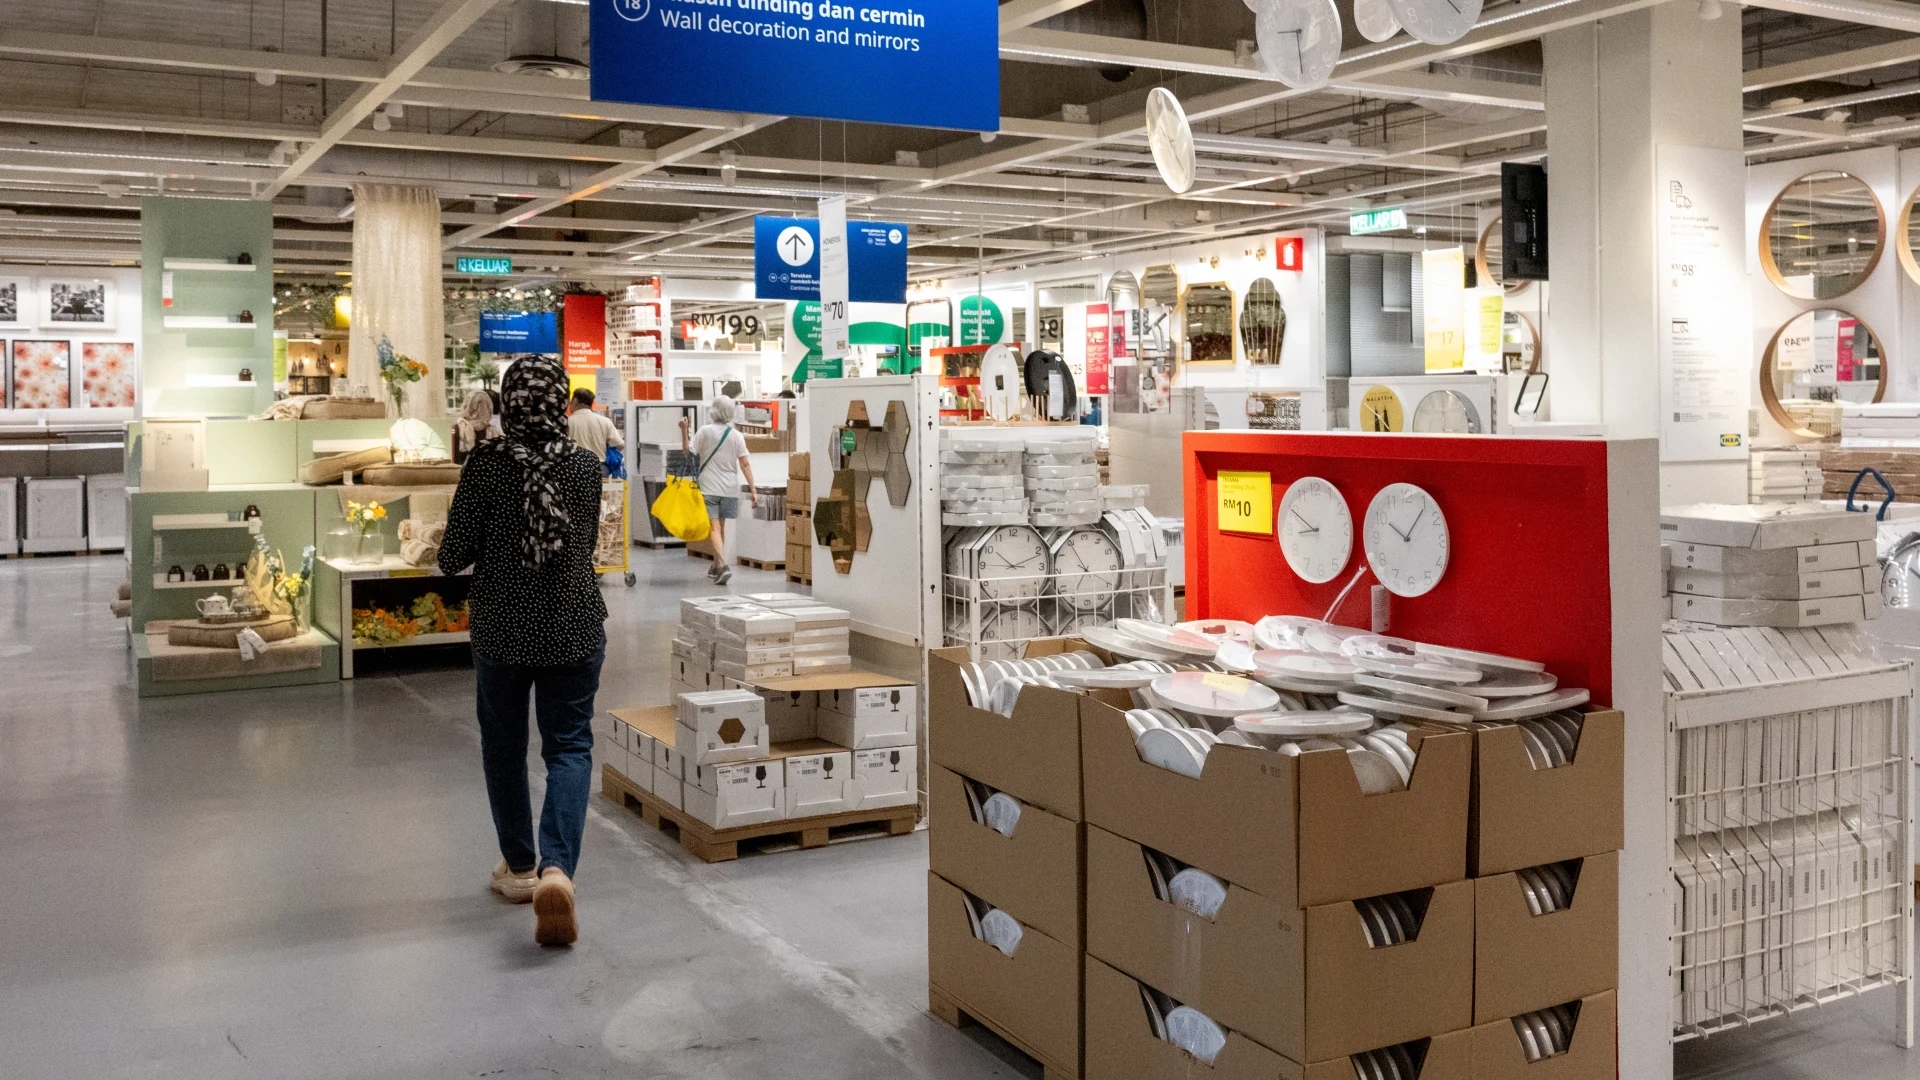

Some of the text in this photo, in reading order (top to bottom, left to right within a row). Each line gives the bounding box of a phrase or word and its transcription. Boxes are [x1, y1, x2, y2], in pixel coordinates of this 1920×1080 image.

[819, 0, 855, 20] dan
[859, 8, 925, 28] cermin
[660, 9, 920, 52] Wall decoration and mirrors
[1352, 211, 1392, 232] KELUAR
[468, 258, 509, 273] KELUAR
[806, 305, 822, 313] Man
[824, 301, 844, 320] RM70
[691, 313, 758, 336] RM199
[802, 314, 816, 322] dan
[568, 341, 591, 350] Harga
[568, 348, 602, 356] terendah
[1310, 482, 1320, 495] 12
[1298, 489, 1306, 502] 11
[1401, 488, 1413, 503] 12
[1223, 499, 1251, 517] RM10
[1337, 502, 1345, 515] 2
[1386, 495, 1396, 510] 11
[1376, 511, 1388, 525] 10
[1432, 511, 1441, 526] 2
[1009, 529, 1018, 537] 12
[1286, 523, 1293, 536] 9
[1343, 522, 1349, 536] 3
[995, 534, 1002, 542] 11
[1372, 531, 1380, 544] 9
[1438, 533, 1445, 548] 3
[985, 546, 994, 554] 10
[1035, 546, 1042, 555] 2
[1291, 543, 1299, 556] 8
[1304, 557, 1311, 571] 7
[1331, 558, 1340, 571] 5
[1378, 552, 1387, 566] 8
[1038, 563, 1045, 571] 3
[1317, 564, 1325, 577] 6
[1391, 568, 1400, 583] 7
[1424, 571, 1432, 585] 5
[1407, 576, 1416, 590] 6
[986, 631, 994, 639] 10
[981, 646, 987, 654] 9
